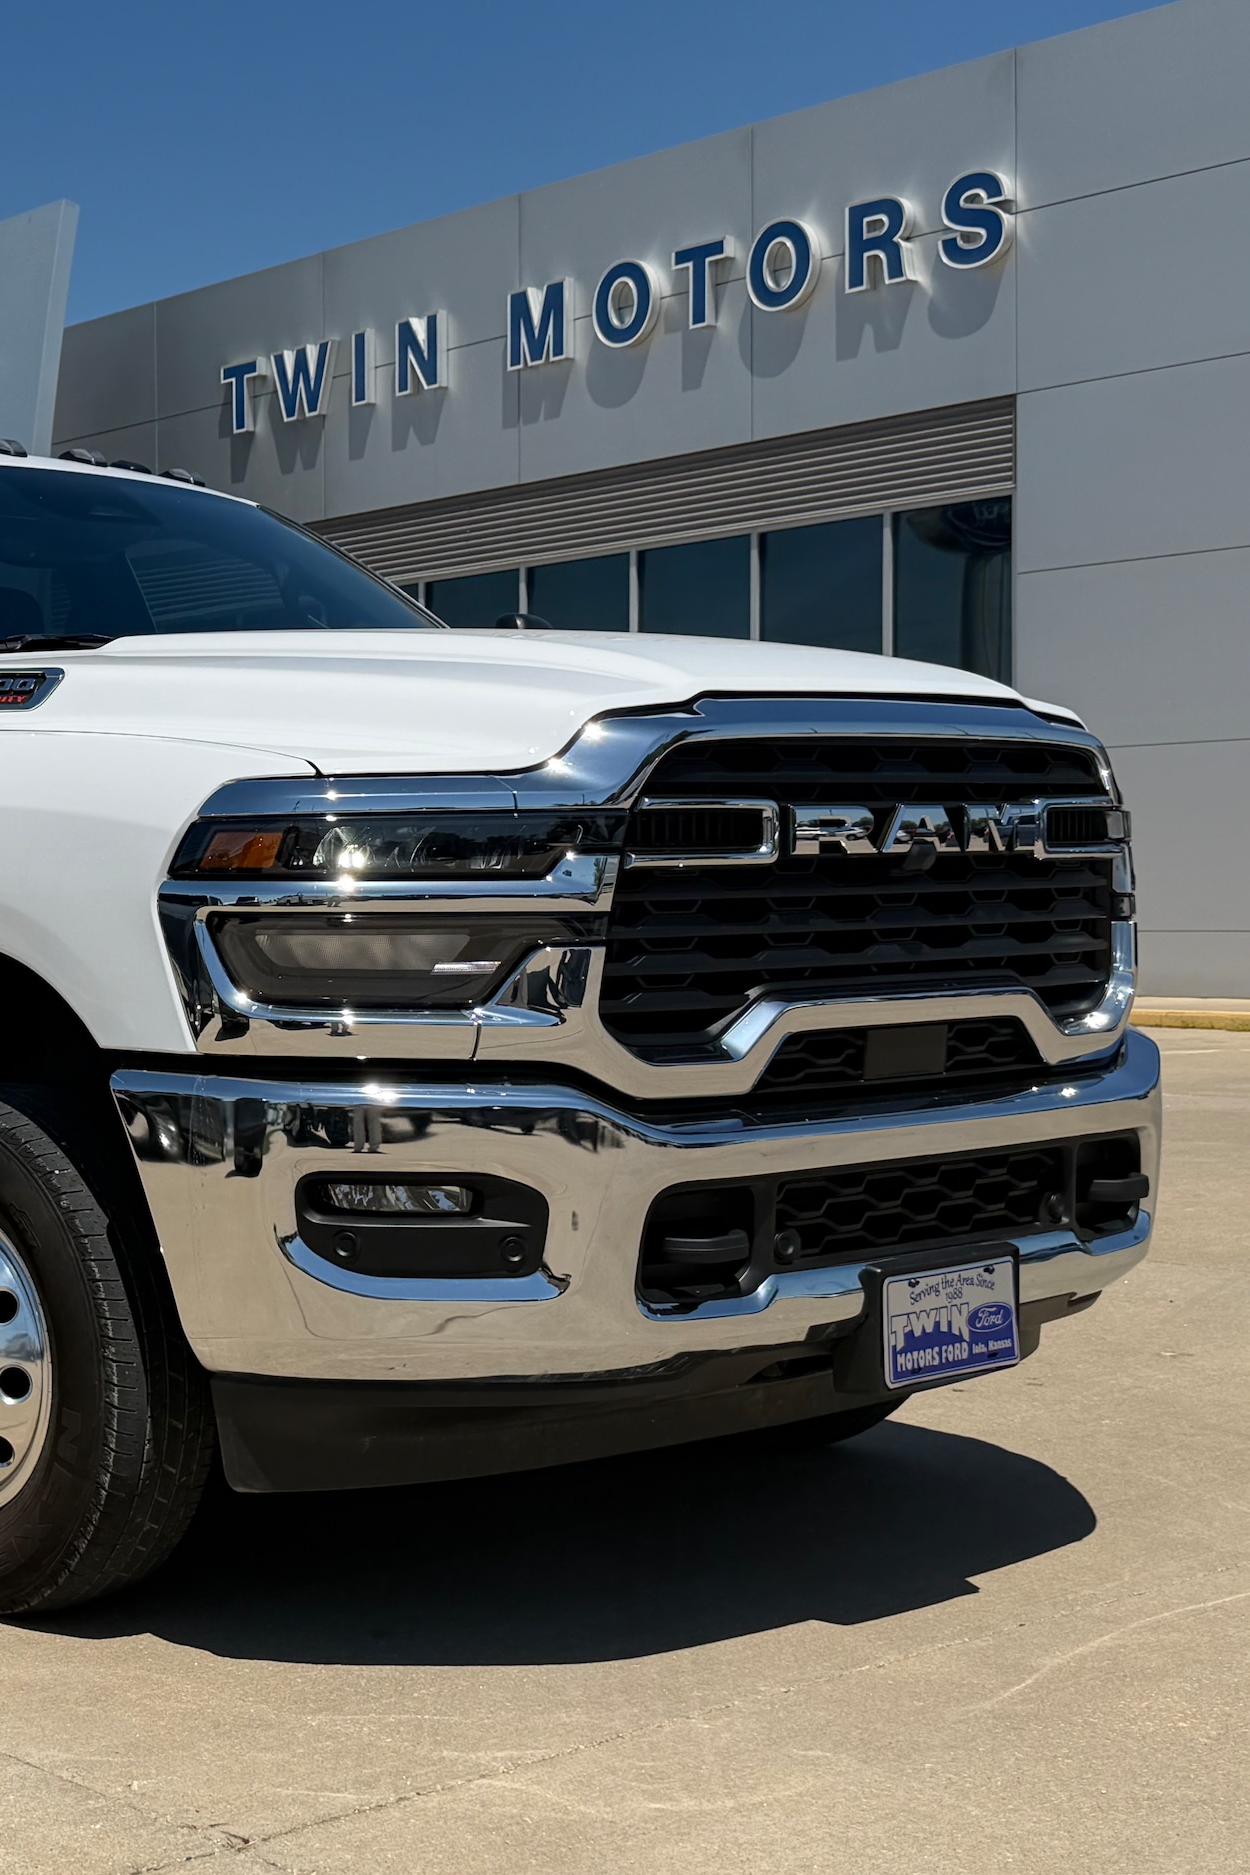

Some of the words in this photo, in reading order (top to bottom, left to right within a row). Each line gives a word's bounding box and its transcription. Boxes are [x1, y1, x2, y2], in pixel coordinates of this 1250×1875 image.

[220, 309, 448, 434] TWIN
[507, 168, 1016, 372] MOTORS
[788, 803, 1038, 854] RAM
[909, 1280, 941, 1305] Serving
[941, 1275, 954, 1290] the
[956, 1273, 975, 1287] Area
[975, 1274, 995, 1291] Since
[945, 1287, 963, 1303] 1988
[890, 1302, 970, 1352] TWIN
[975, 1307, 1004, 1328] Ford
[897, 1348, 940, 1372] MOTORS
[941, 1341, 969, 1364] FORD
[988, 1338, 1012, 1351] Kansas
